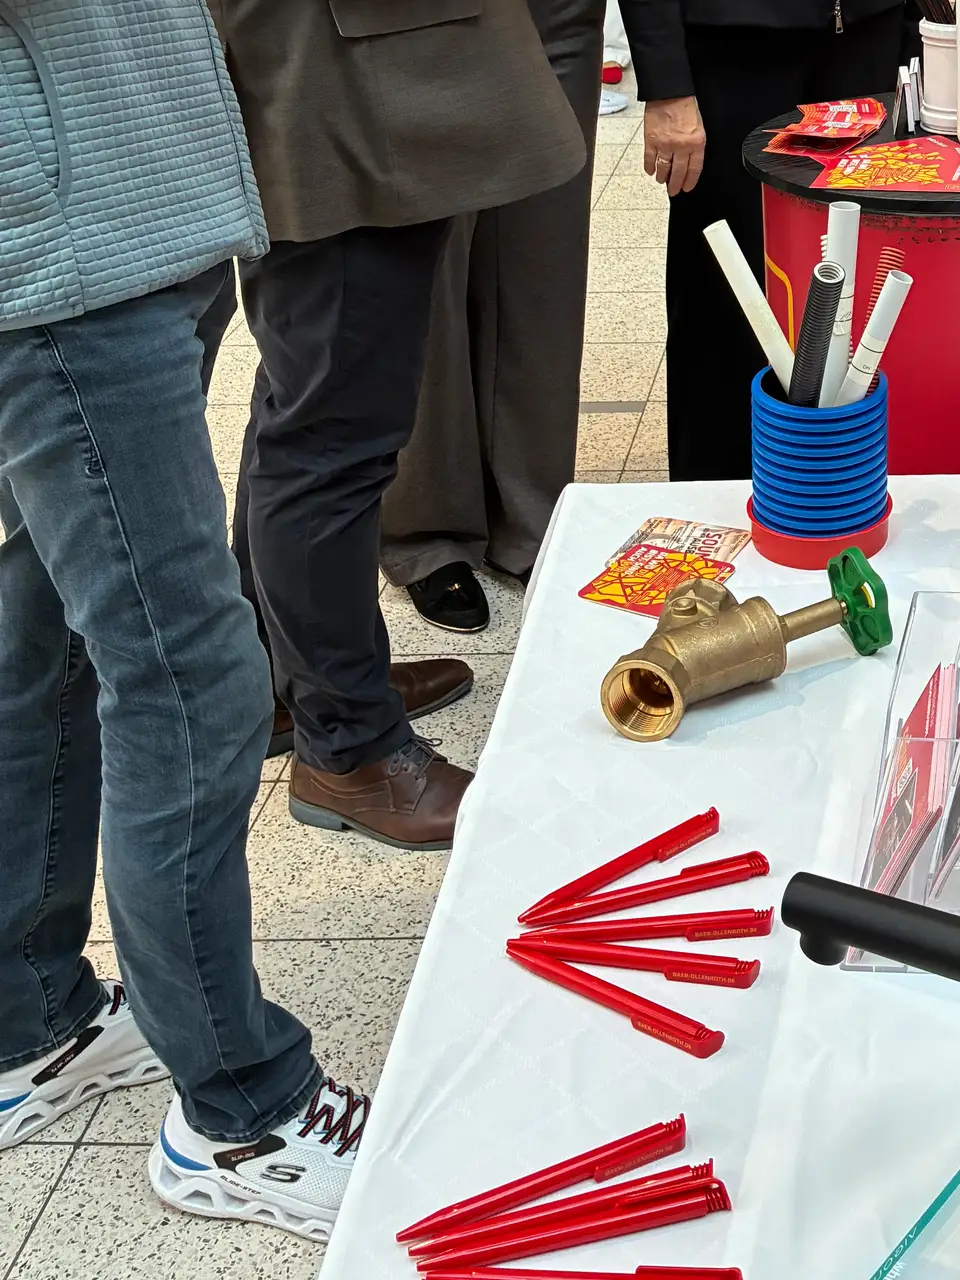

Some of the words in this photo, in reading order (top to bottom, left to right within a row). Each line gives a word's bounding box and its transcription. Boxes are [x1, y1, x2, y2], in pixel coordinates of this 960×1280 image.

[694, 927, 757, 938] BAER-OLLENROTH.DE
[672, 971, 736, 984] BAER-OLLENROTH.DE
[637, 1021, 692, 1050] BAER-OLLENROTH.DE
